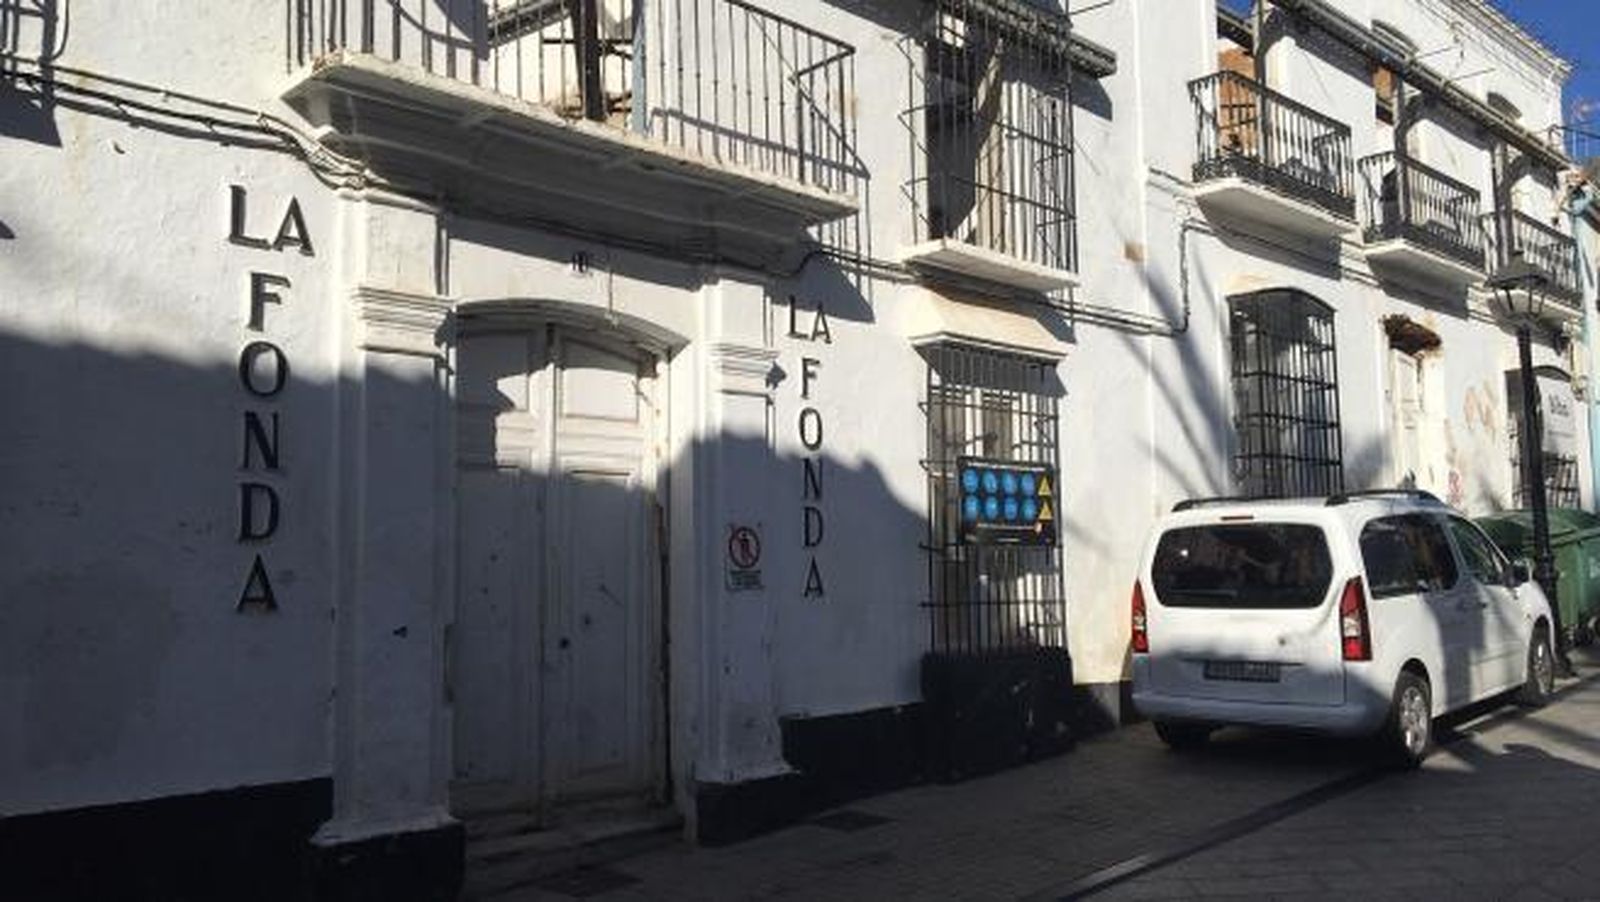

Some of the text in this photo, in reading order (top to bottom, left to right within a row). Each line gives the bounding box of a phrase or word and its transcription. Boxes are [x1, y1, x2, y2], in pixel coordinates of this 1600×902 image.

[227, 184, 315, 257] LA
[787, 294, 832, 344] LA
[234, 271, 292, 614] FONDA
[798, 357, 825, 599] FONDA
